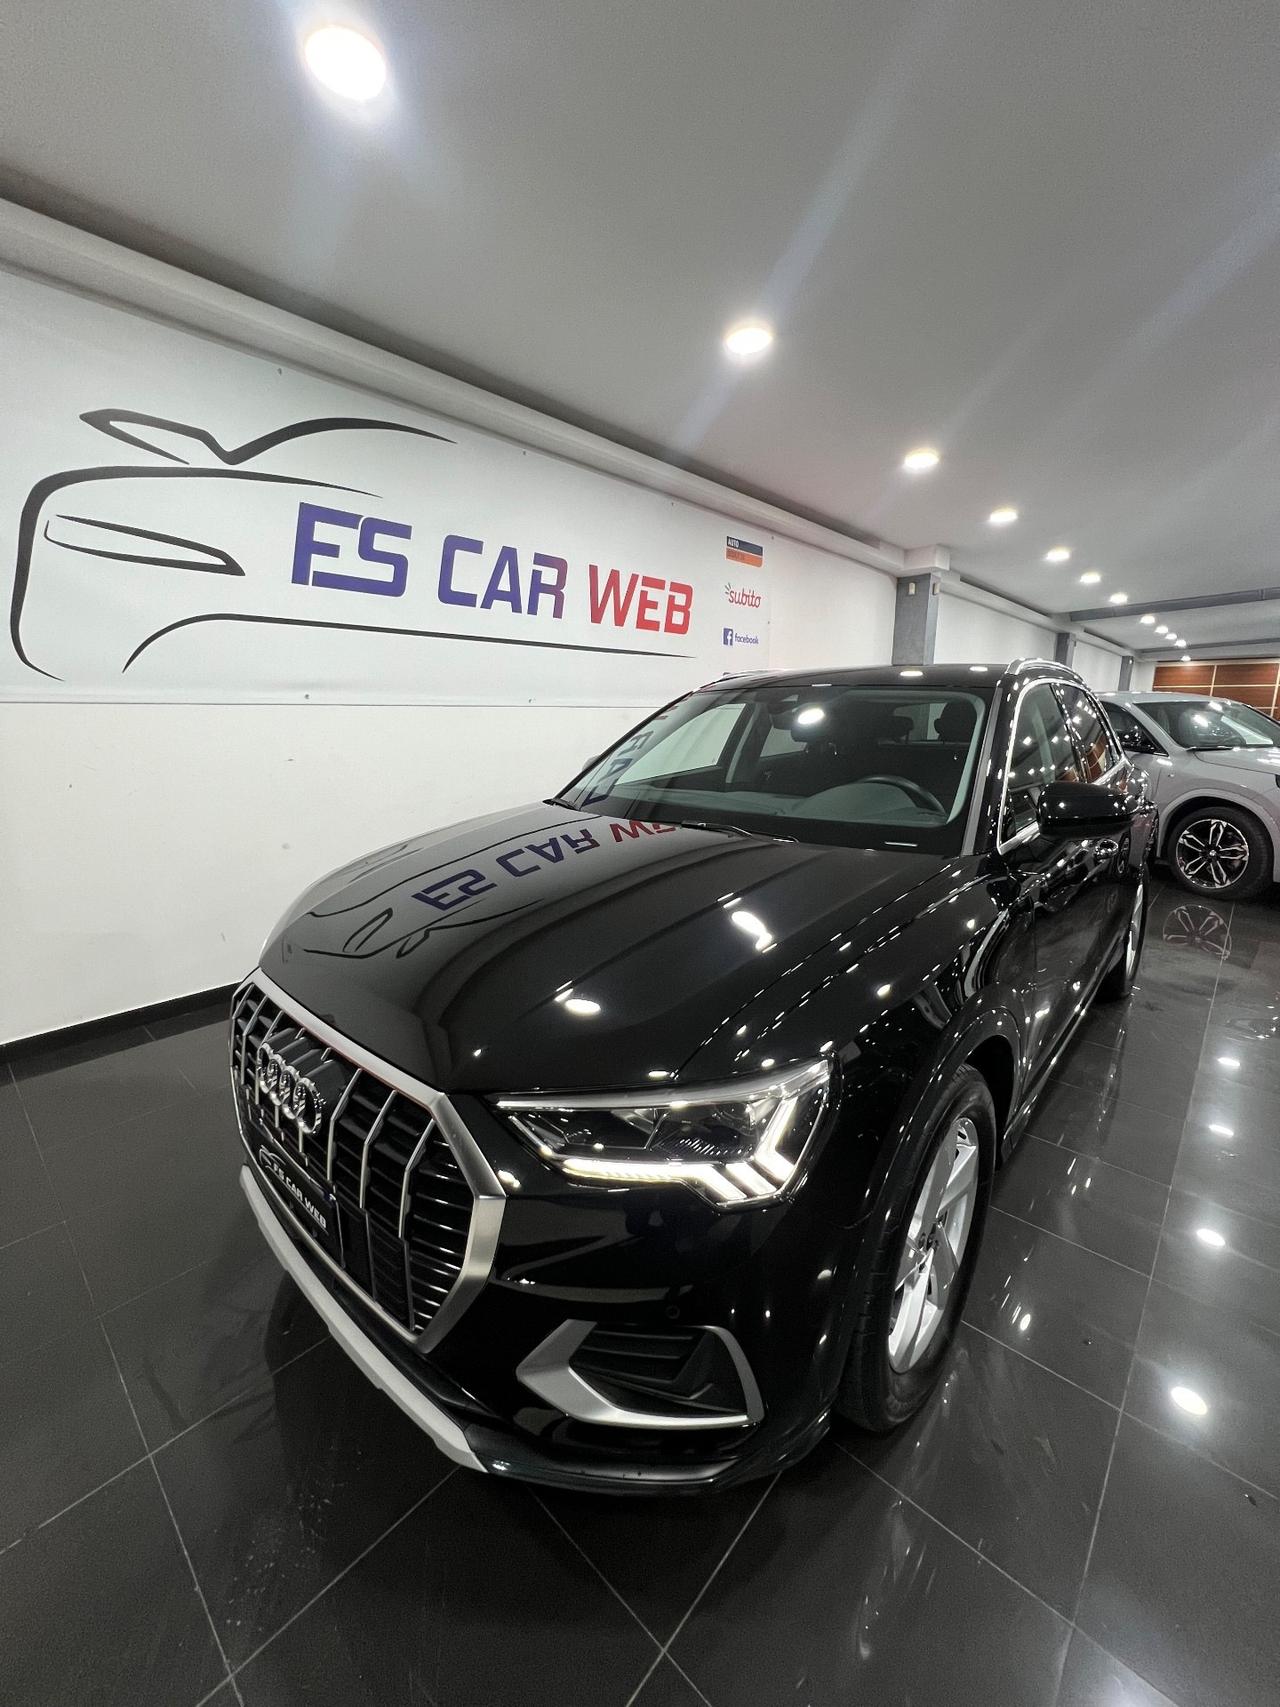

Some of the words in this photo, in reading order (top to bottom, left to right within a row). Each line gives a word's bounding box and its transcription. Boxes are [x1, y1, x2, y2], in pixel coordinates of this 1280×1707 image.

[291, 502, 412, 598] ES
[437, 534, 568, 619] CAR
[589, 564, 694, 635] WEB
[728, 587, 761, 608] subito
[735, 633, 759, 644] facebook
[286, 1177, 303, 1202] CAR
[304, 1197, 327, 1229] WEB
